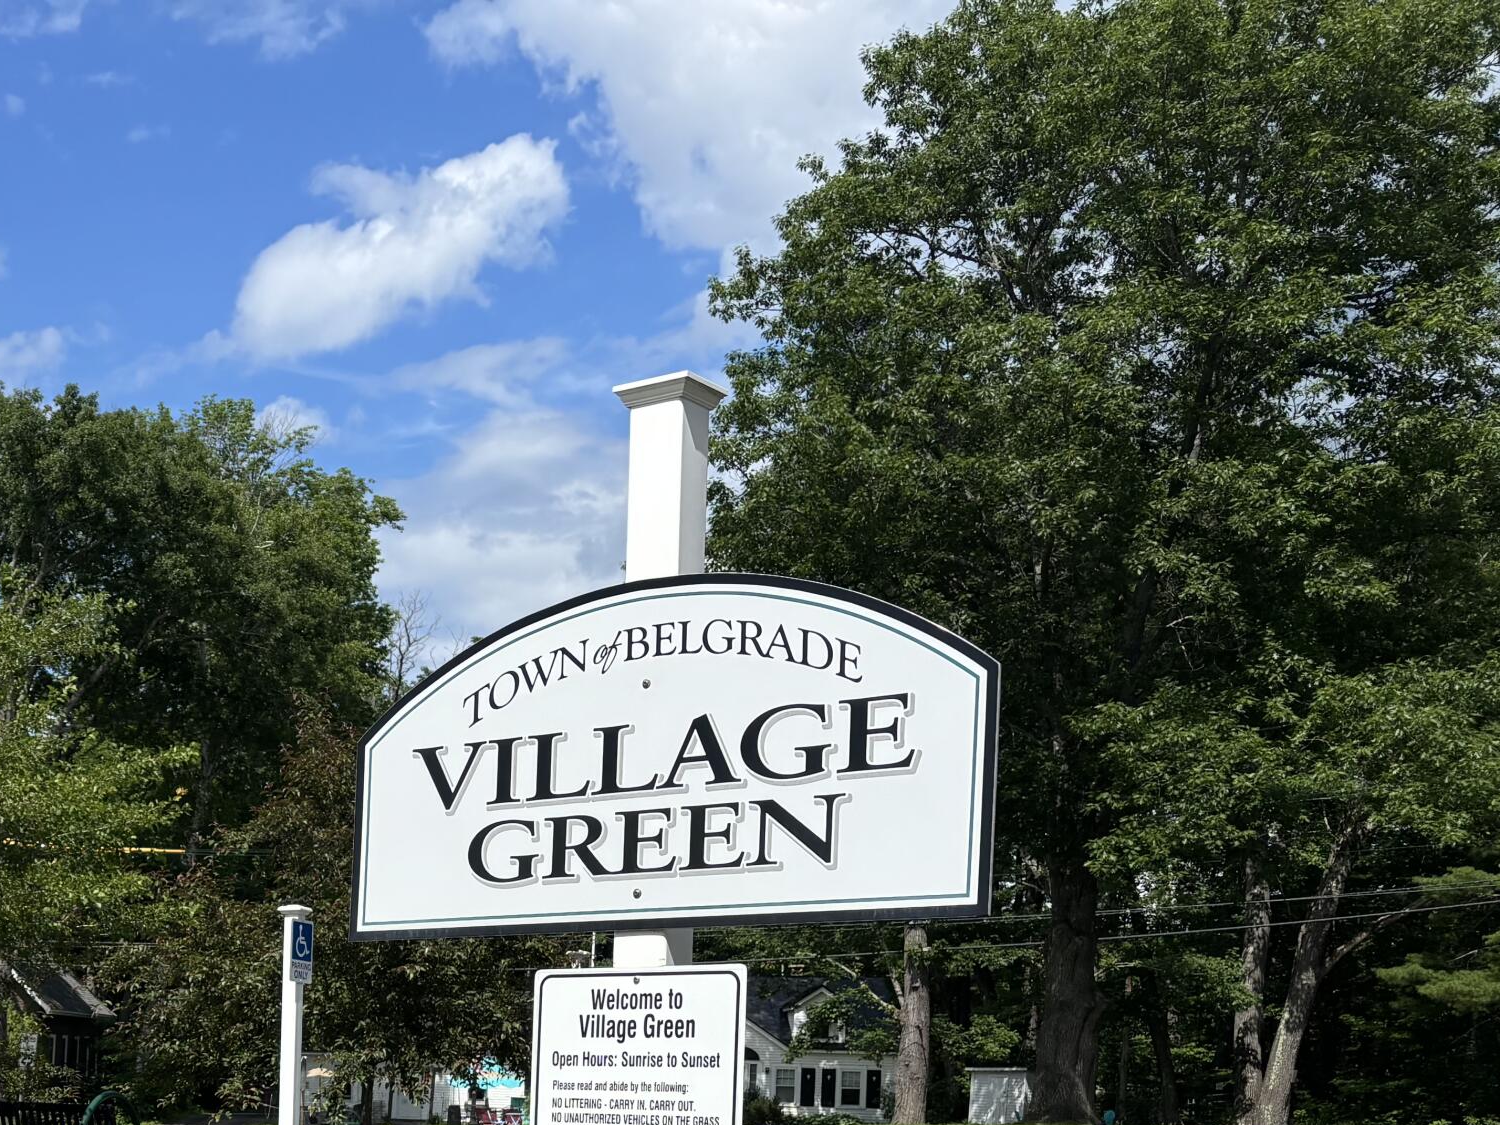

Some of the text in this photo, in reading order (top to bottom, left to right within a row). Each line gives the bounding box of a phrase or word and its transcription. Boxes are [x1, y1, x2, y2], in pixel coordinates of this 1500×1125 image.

[462, 619, 864, 729] TOWN of BELGRADE
[412, 692, 923, 816] VILLAGE
[466, 792, 853, 888] GREEN
[292, 961, 311, 971] PARKING
[293, 969, 309, 980] ONLY
[591, 988, 683, 1010] Welcome to
[579, 1013, 696, 1043] Village Green
[552, 1051, 721, 1070] Open Hours: Sunrise to Sunset
[552, 1080, 689, 1095] Please read and abide by the following:
[552, 1097, 563, 1109] NO
[564, 1098, 602, 1110] LITTERING
[609, 1099, 635, 1110] CARRY
[649, 1100, 676, 1112] CARRY
[677, 1100, 697, 1112] OUT.
[551, 1112, 562, 1123] NO
[564, 1112, 621, 1125] UNAUTHORIZED
[623, 1114, 660, 1125] VEHICLES
[662, 1115, 673, 1125] ON
